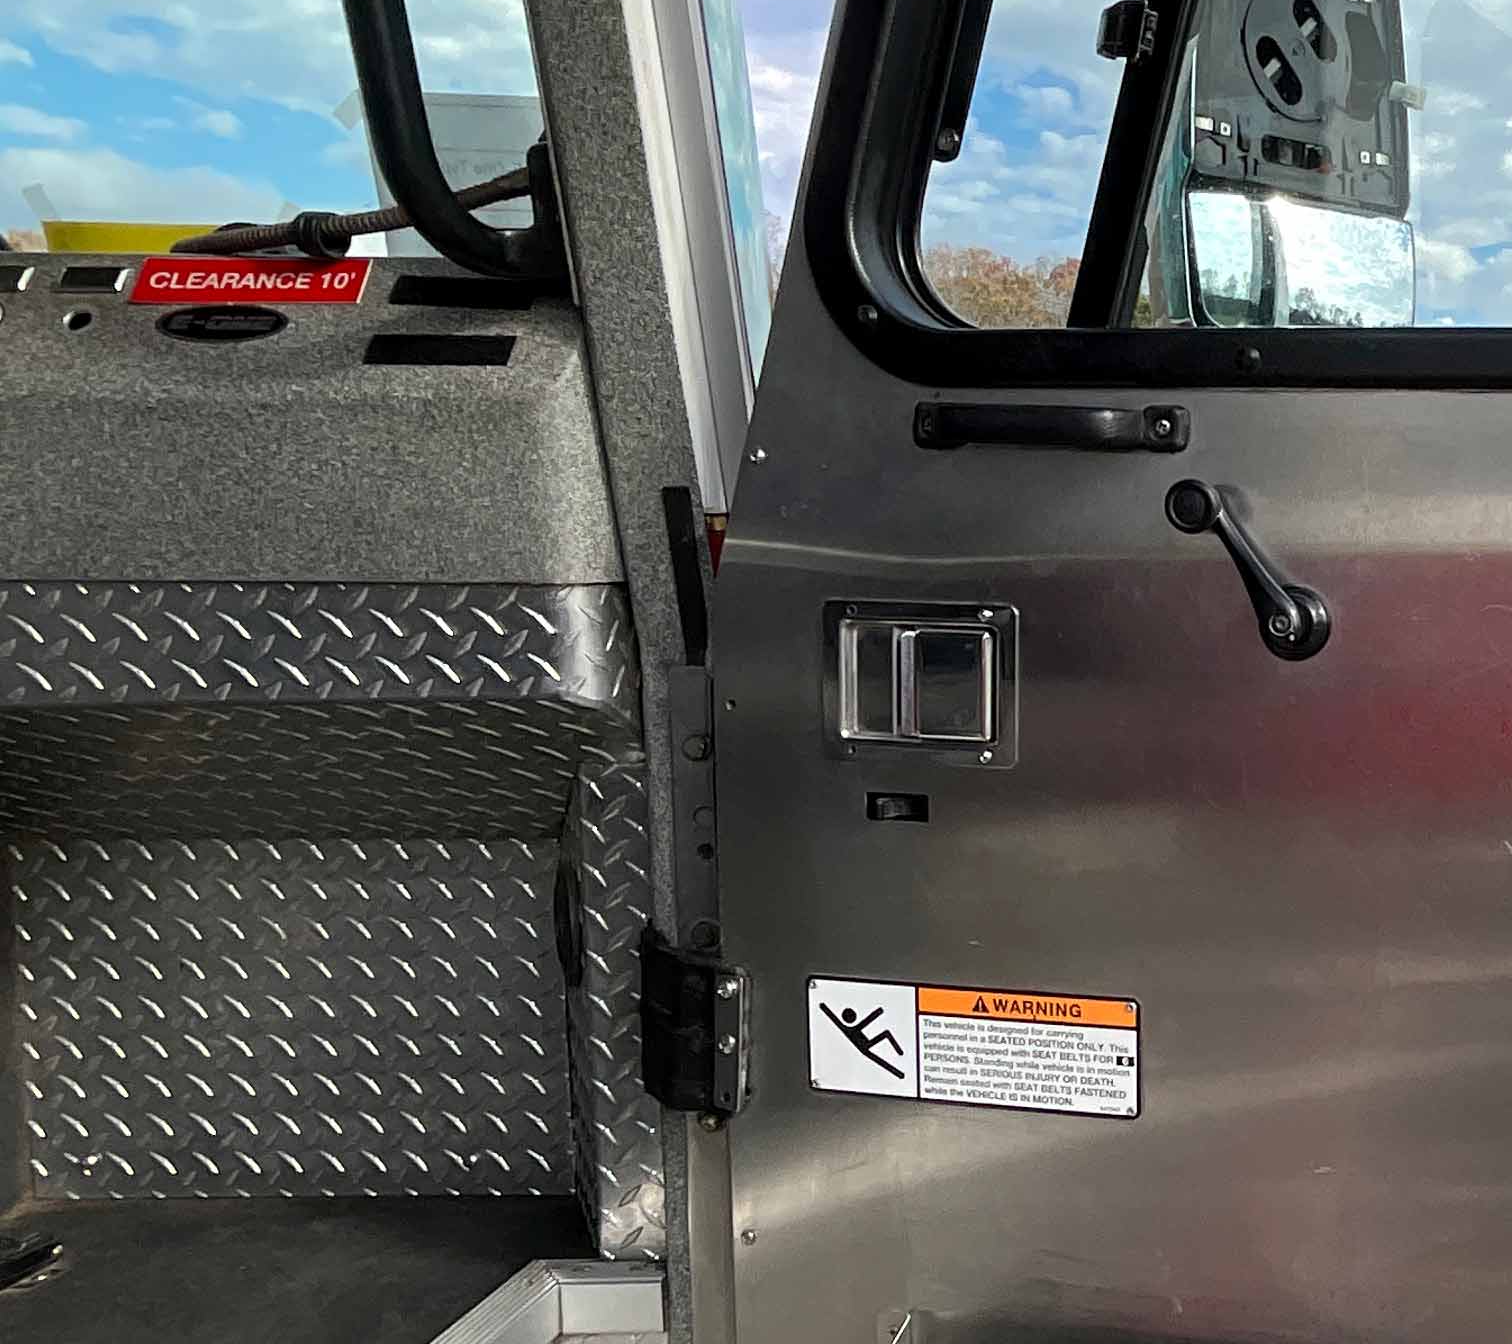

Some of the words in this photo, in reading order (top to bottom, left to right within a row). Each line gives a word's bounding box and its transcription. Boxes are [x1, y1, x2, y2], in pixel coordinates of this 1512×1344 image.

[149, 271, 313, 289] CLEARANCE
[319, 271, 355, 289] 10'
[994, 998, 1081, 1018] WARNING
[923, 1019, 941, 1027] This
[944, 1021, 975, 1030] vehicle
[987, 1025, 1028, 1036] designed
[1031, 1028, 1042, 1036] for
[1046, 1030, 1083, 1040] carrying
[923, 1030, 968, 1042] personnel
[988, 1035, 1025, 1046] SEATED
[1029, 1038, 1074, 1050] POSITION
[1110, 1044, 1129, 1053] This
[924, 1042, 954, 1052] vehicle
[967, 1046, 1008, 1058] equipped
[1011, 1049, 1030, 1058] with
[1032, 1050, 1056, 1060] SEAT
[1060, 1052, 1091, 1062] BELTS
[1093, 1055, 1113, 1064] FOR
[942, 1066, 967, 1075] result
[980, 1068, 1023, 1079] SERIOUS
[1025, 1072, 1060, 1082] INJURY
[1063, 1075, 1077, 1084] OR
[974, 1057, 1014, 1069] Standing
[1016, 1061, 1039, 1069] while
[1043, 1063, 1074, 1072] vehicle
[1097, 1068, 1130, 1076] motion
[960, 1079, 991, 1088] seated
[1014, 1083, 1038, 1092] SEAT
[1041, 1085, 1072, 1095] BELTS
[1074, 1087, 1126, 1099] FASTENED
[966, 1089, 1007, 1100] VEHICLE
[1009, 1093, 1018, 1101] IS
[1020, 1094, 1030, 1102] IN
